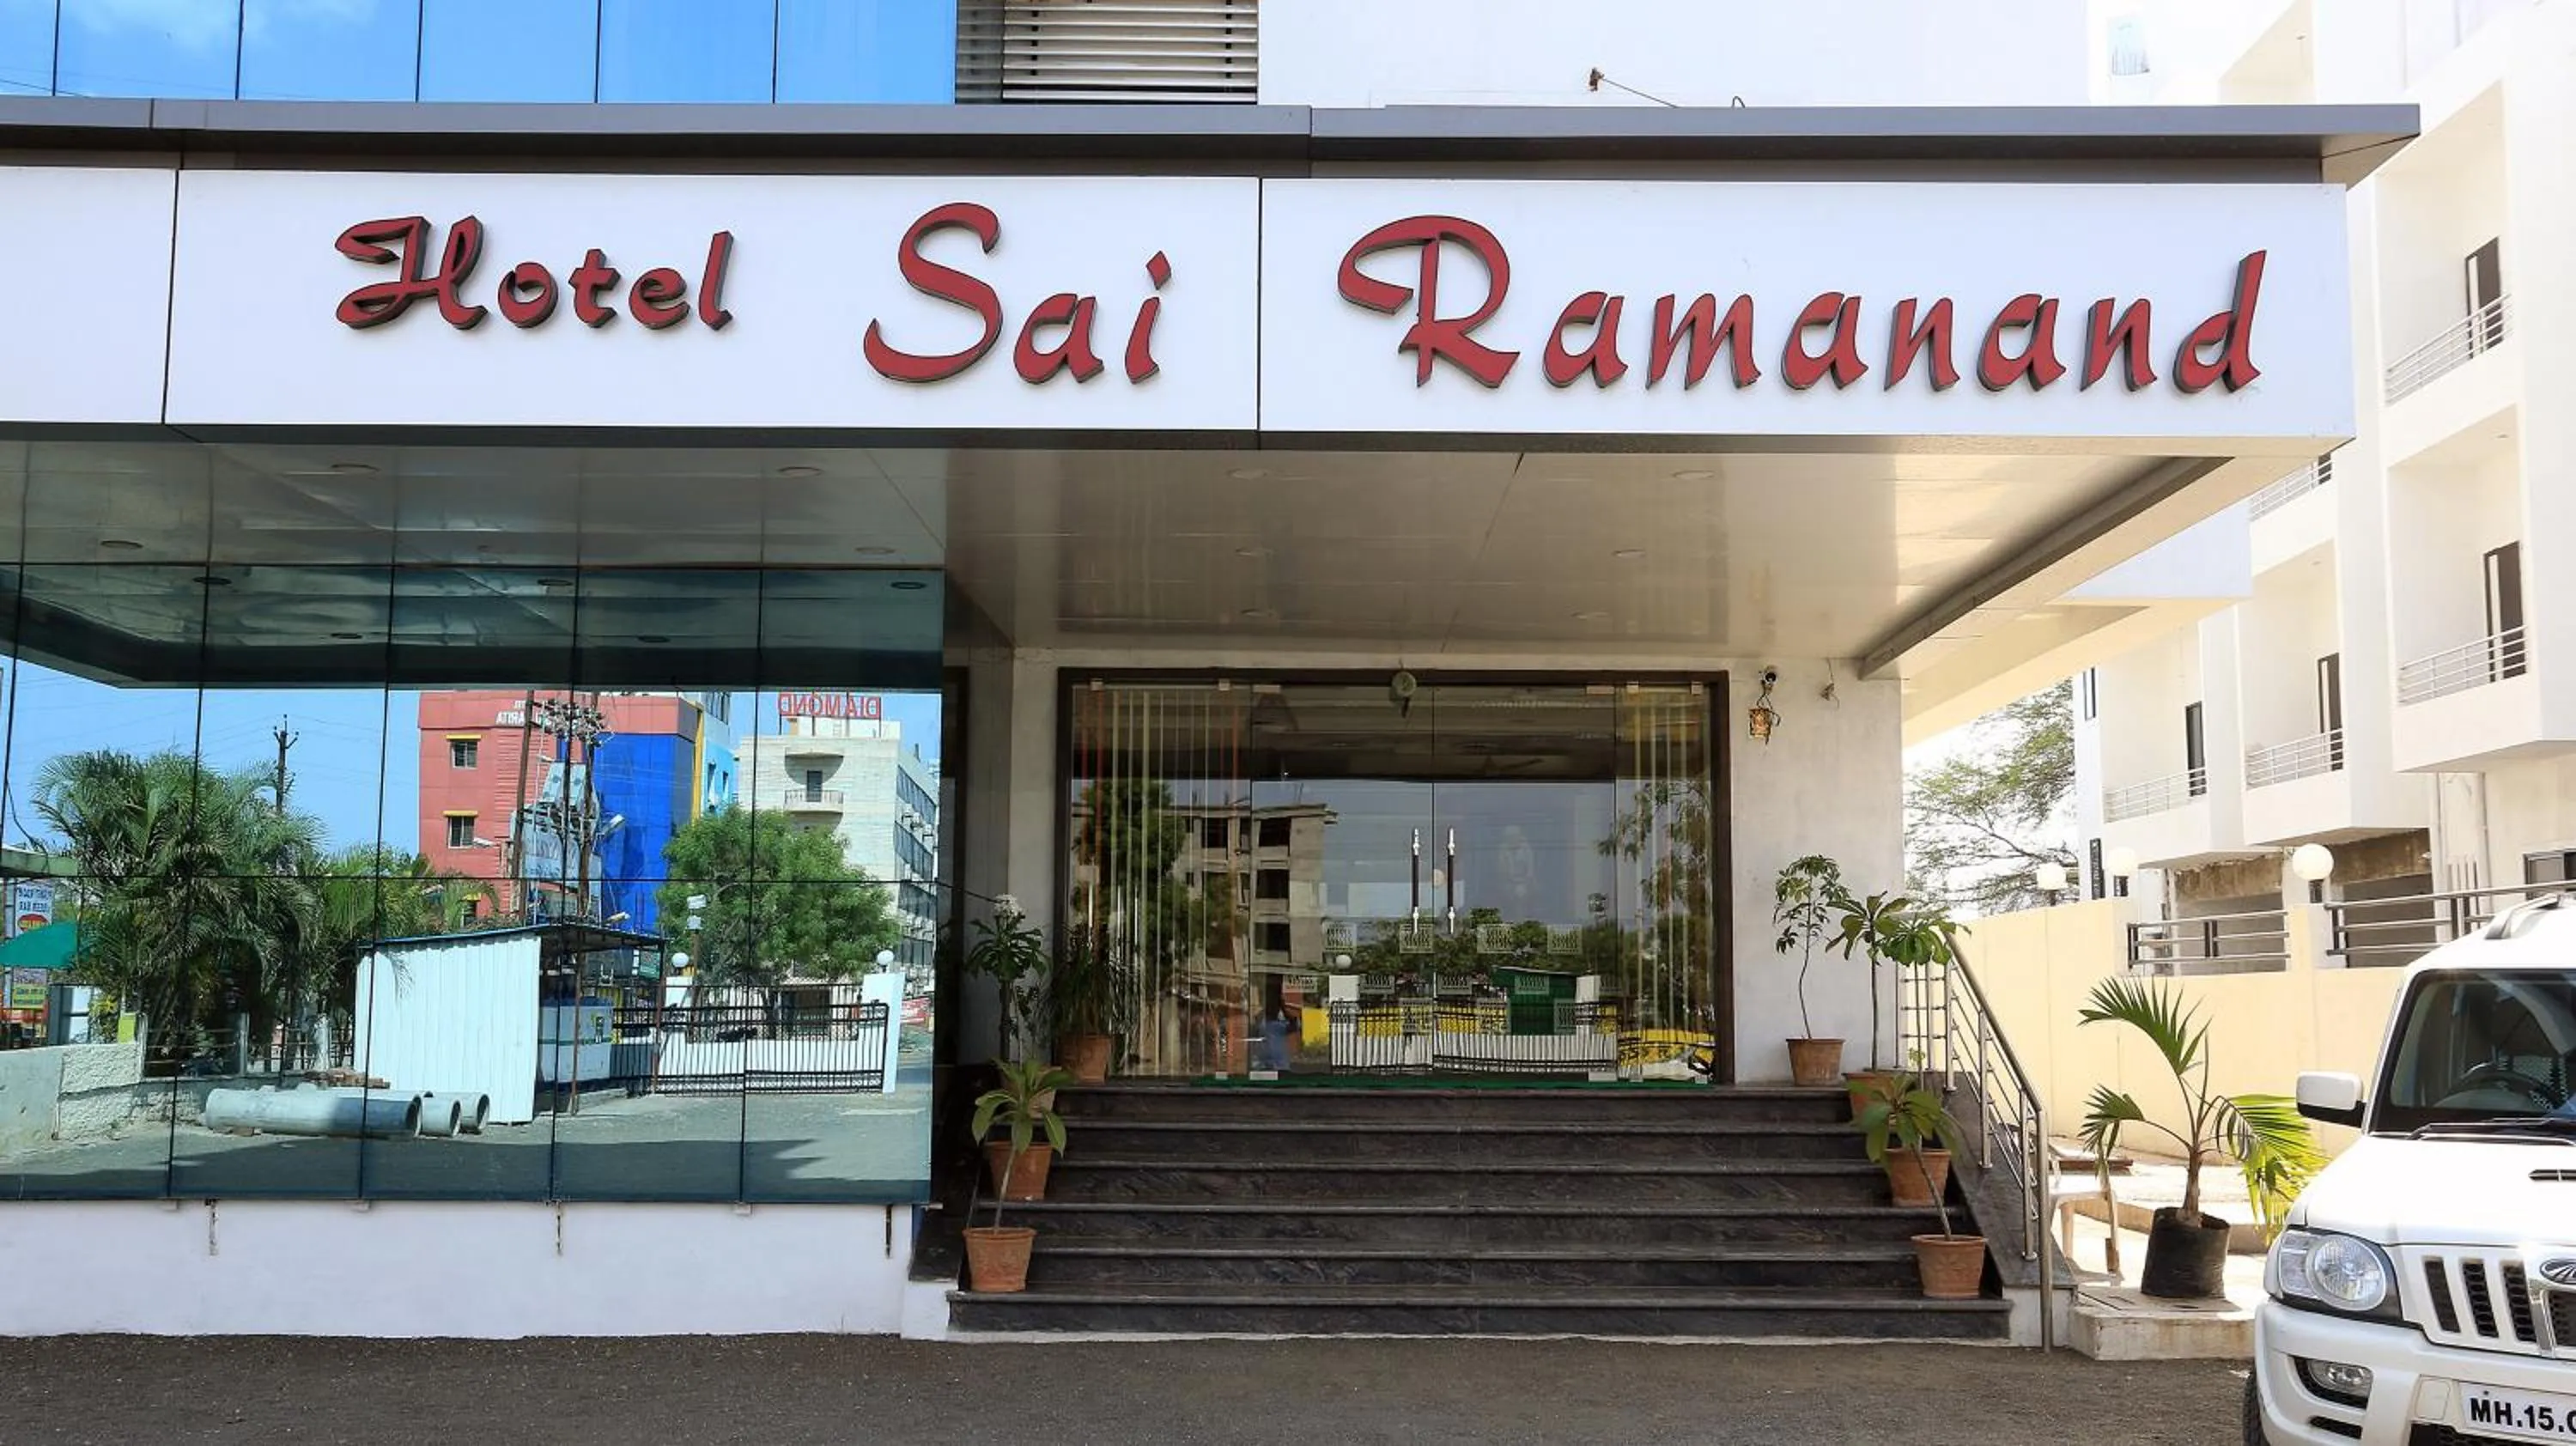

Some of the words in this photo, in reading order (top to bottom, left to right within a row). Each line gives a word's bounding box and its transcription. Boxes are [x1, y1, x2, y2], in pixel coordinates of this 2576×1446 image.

[334, 213, 736, 332] Hotel
[862, 201, 1173, 386] Sai
[1337, 213, 2269, 392] Ramanand
